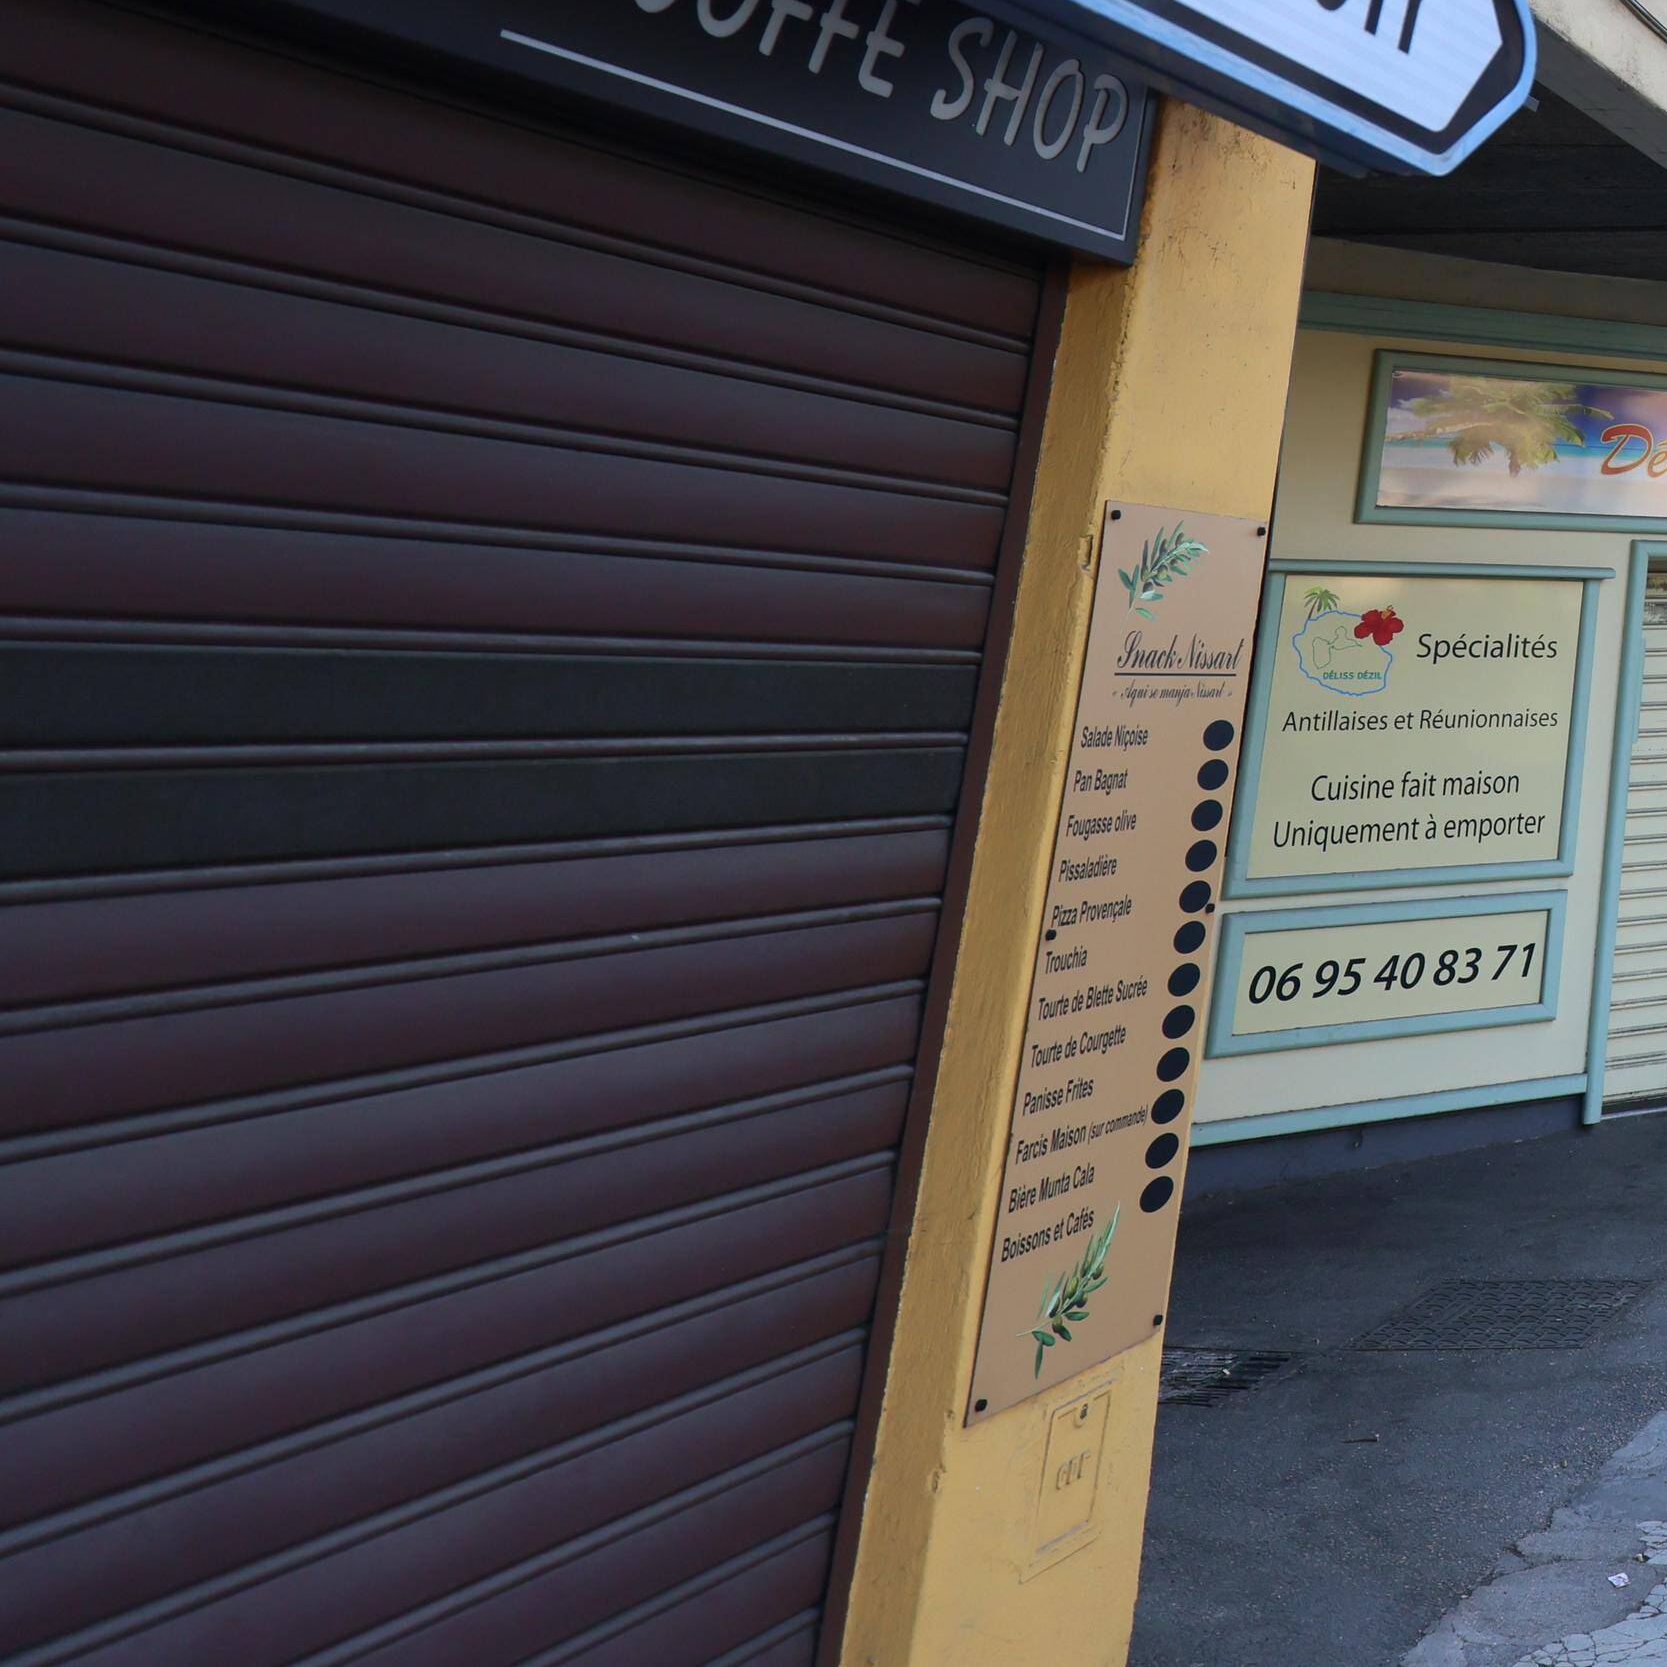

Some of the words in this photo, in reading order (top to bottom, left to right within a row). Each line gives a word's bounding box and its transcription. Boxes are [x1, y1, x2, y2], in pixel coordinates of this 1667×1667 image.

[929, 15, 1131, 174] SHOP
[1177, 633, 1245, 670] Nissart
[1416, 633, 1559, 665] Spécialités
[1322, 669, 1355, 681] DÉLISS
[1357, 669, 1383, 681] DÉZIL
[1282, 710, 1389, 733] Antillaises
[1394, 712, 1415, 731] et
[1419, 707, 1559, 730] Réunionnaises
[1080, 725, 1113, 748] Salade
[1114, 724, 1148, 752] Niçoise
[1073, 770, 1092, 793] Pan
[1094, 768, 1128, 796] Bagnat
[1310, 774, 1395, 802] Cuisine
[1400, 770, 1437, 799] fait
[1442, 770, 1520, 797] maison
[1066, 814, 1113, 841] Fougasse
[1114, 809, 1137, 832] olive
[1273, 817, 1420, 853] Uniquement
[1425, 813, 1437, 840] à
[1443, 812, 1547, 844] emporter
[1058, 854, 1117, 883] Pissaladière
[1051, 905, 1078, 928] Pizza
[1079, 894, 1132, 924] Provençale
[1045, 945, 1088, 975] Trouchia
[1248, 962, 1304, 1005] 06
[1312, 957, 1367, 999] 95
[1373, 952, 1426, 992] 40
[1432, 947, 1483, 986] 83
[1490, 942, 1537, 982] 71
[1038, 995, 1069, 1021] Tourte
[1071, 990, 1084, 1013] de
[1085, 985, 1114, 1010] Blette
[1115, 974, 1148, 1003] Sucrée
[1031, 1040, 1062, 1069] Tourte
[1064, 1035, 1077, 1059] de
[1079, 1024, 1126, 1054] Courgette
[1022, 1087, 1063, 1117] Panisse
[1065, 1078, 1094, 1103] Frites
[1015, 1133, 1049, 1165] Farcis
[1050, 1125, 1086, 1153] Maison
[1087, 1121, 1104, 1145] (sur
[1008, 1185, 1037, 1214] Bière
[1038, 1171, 1071, 1202] Munta
[1073, 1161, 1095, 1188] Cala
[1001, 1228, 1050, 1263] Boissons
[1053, 1217, 1065, 1241] et
[1066, 1206, 1095, 1237] Cafés
